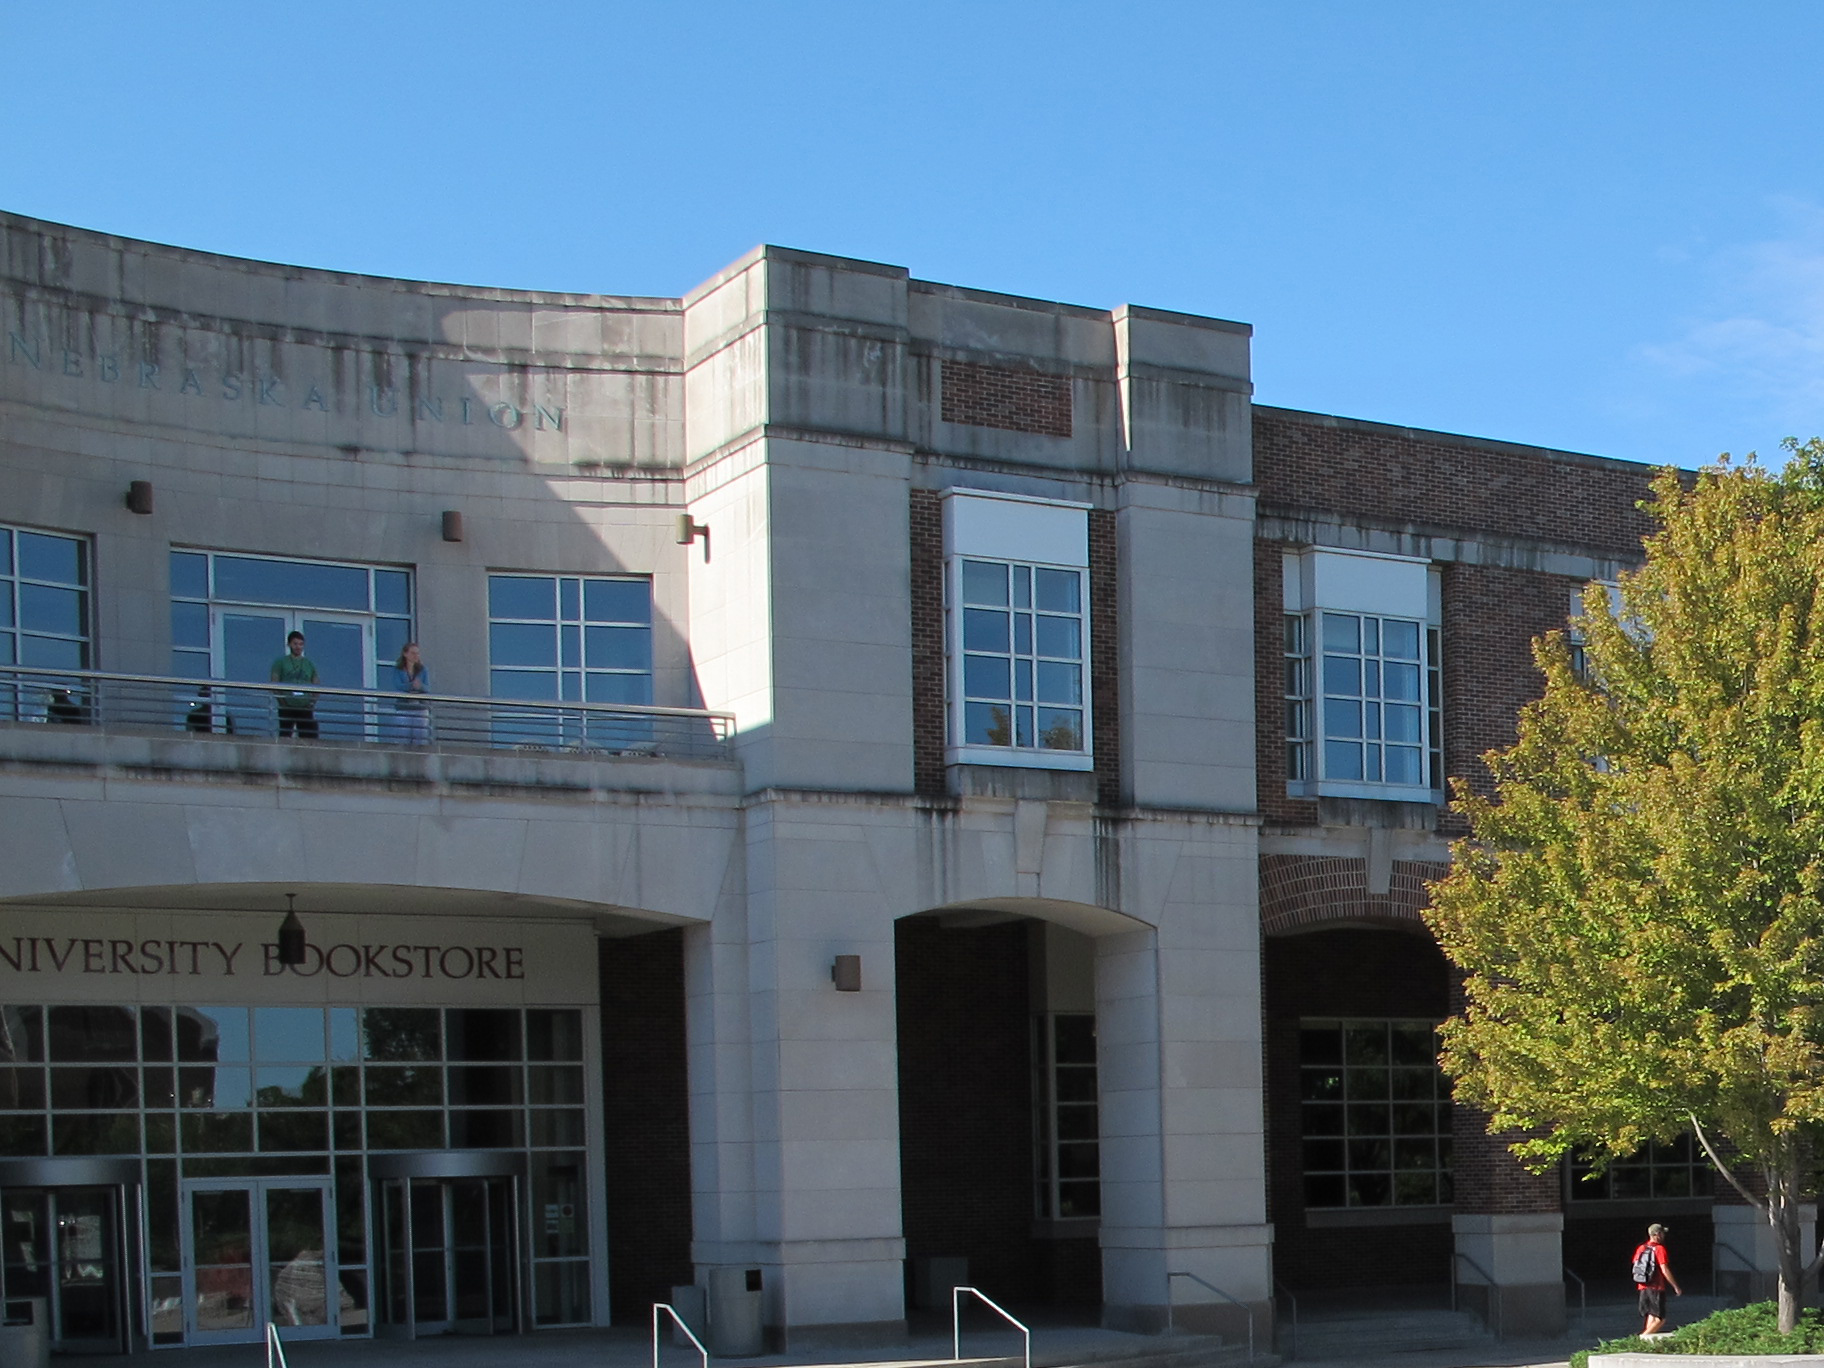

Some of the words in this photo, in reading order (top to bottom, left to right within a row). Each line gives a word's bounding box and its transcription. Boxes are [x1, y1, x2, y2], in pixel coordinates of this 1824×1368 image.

[9, 331, 330, 412] NEBRASKA
[369, 385, 567, 432] UNION
[261, 943, 525, 979] BOOKSTORE
